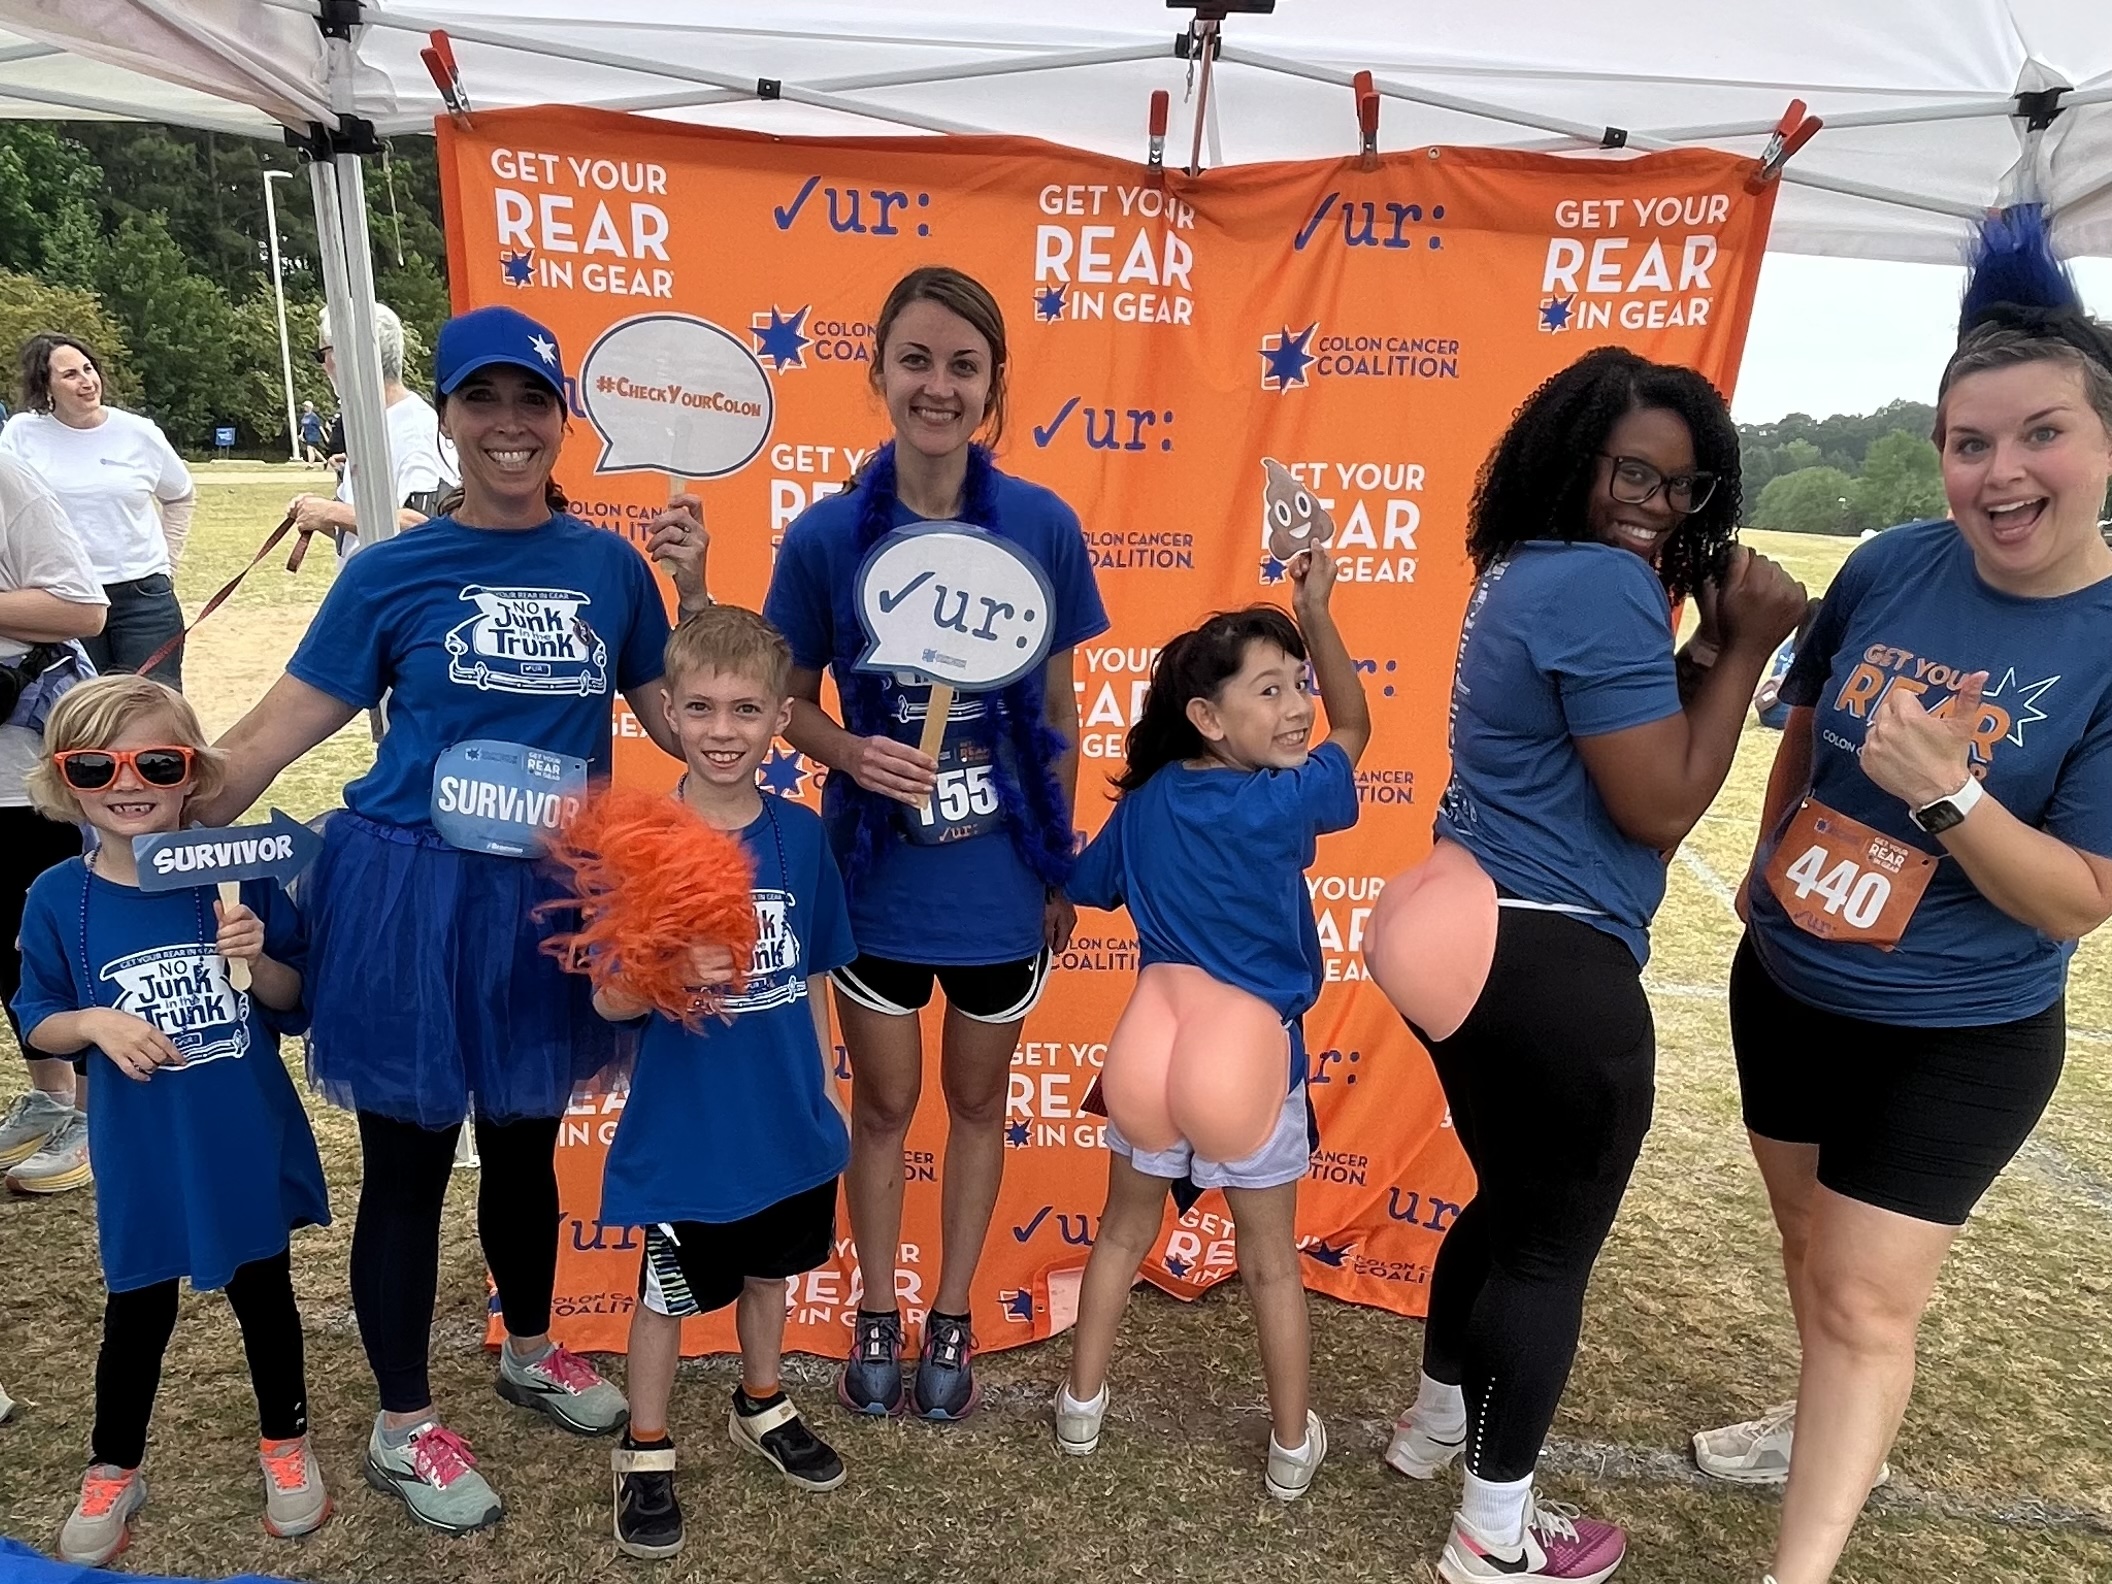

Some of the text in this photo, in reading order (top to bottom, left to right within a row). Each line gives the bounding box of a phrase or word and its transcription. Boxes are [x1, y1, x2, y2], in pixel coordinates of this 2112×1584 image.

[490, 147, 668, 196] GET YOUR
[1039, 184, 1195, 231] GET YOUR
[1555, 194, 1730, 230] GET YOUR
[494, 187, 671, 262] REAR
[1034, 223, 1194, 292] REAR
[1542, 234, 1718, 294] REAR
[539, 257, 673, 298] IN GEAR
[1071, 290, 1193, 327] IN GEAR
[1576, 299, 1709, 330] IN GEAR
[813, 320, 877, 338] COLON
[1319, 336, 1460, 356] COLON CANCER
[1317, 355, 1460, 379] COALITION
[770, 443, 836, 474] GET
[1290, 462, 1426, 491] ET YOUR
[570, 500, 662, 520] OLON CAN
[1085, 532, 1193, 548] LON CANCER
[1089, 550, 1194, 569] OALITION
[1336, 556, 1417, 583] GEAR
[494, 602, 564, 633] Junk
[512, 601, 539, 615] NO
[488, 629, 576, 659] Trunk
[1863, 643, 1964, 692] GET YOU
[1834, 662, 2010, 764] RR
[1081, 733, 1128, 758] GE
[1822, 729, 1857, 754] COLON
[528, 759, 561, 775] REAR
[1353, 770, 1414, 784] ANCER
[152, 834, 294, 875] SURVIVOR
[1868, 843, 1905, 868] REAR
[1305, 876, 1386, 903] YOUR
[1786, 845, 1891, 929] 440
[163, 949, 186, 959] REAR
[1066, 938, 1139, 951] LON CAN
[158, 959, 187, 978] NO
[1050, 953, 1137, 971] COALITI
[1324, 959, 1375, 983] EA
[138, 964, 213, 1003] Junk
[135, 994, 227, 1031] Trunk
[1010, 1042, 1108, 1068] GET YO
[1306, 1050, 1360, 1085] r:
[1005, 1072, 1098, 1119] RE
[559, 1121, 591, 1147] IN
[1037, 1123, 1108, 1149] IN GE
[903, 1151, 935, 1164] CER
[1311, 1151, 1368, 1169] ANCER
[571, 1220, 646, 1251] ur
[1180, 1206, 1235, 1239] GET
[834, 1237, 921, 1263] YR
[1166, 1229, 1236, 1266] RE
[1354, 1266, 1426, 1285] COALI
[554, 1292, 607, 1305] OLON
[554, 1303, 635, 1317] OALIT
[799, 1307, 832, 1326] IN
